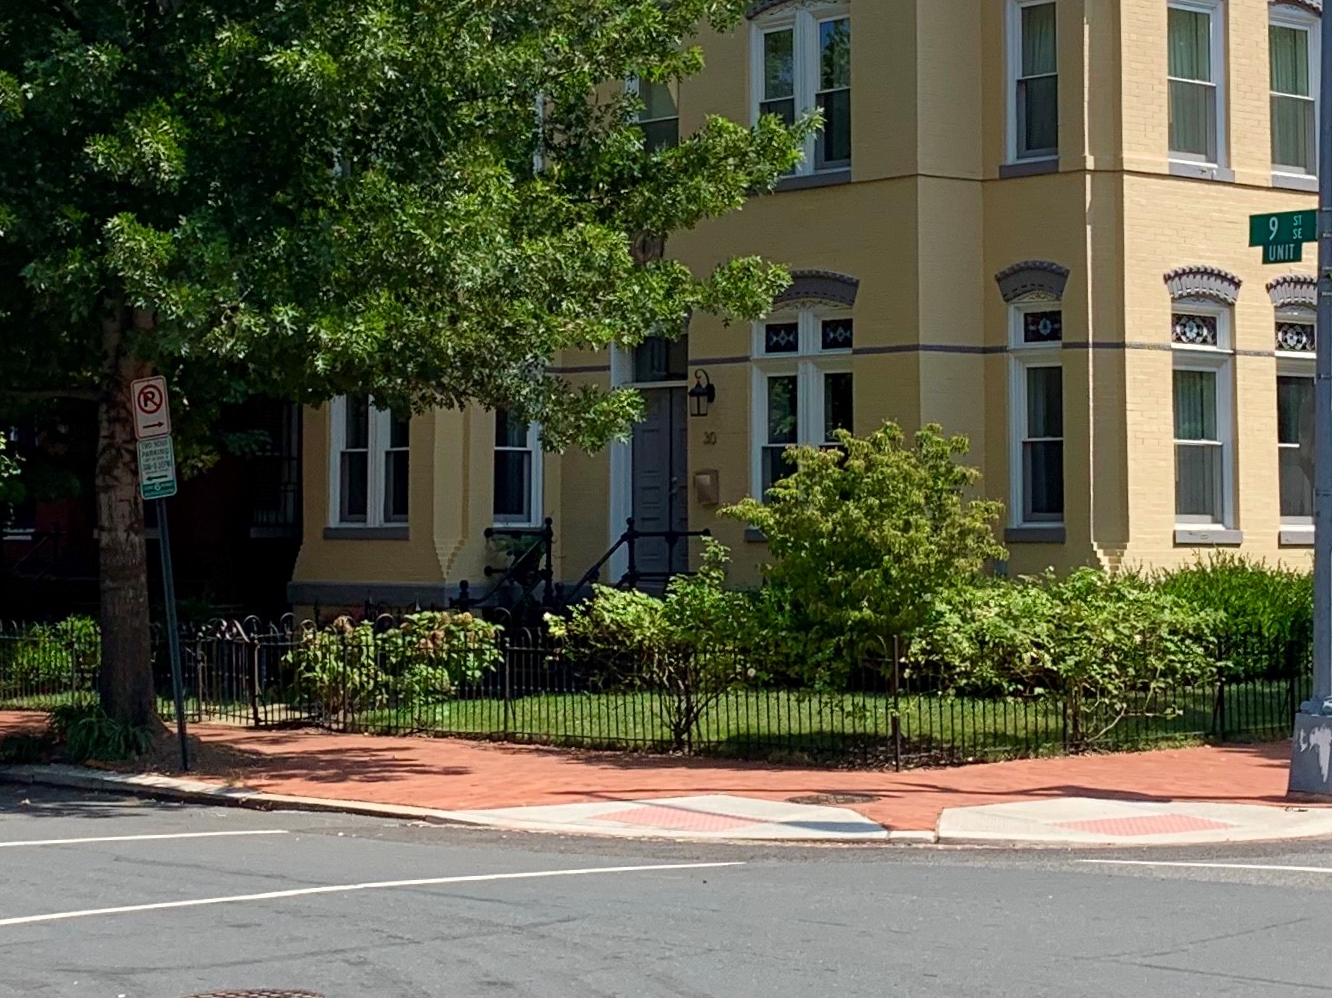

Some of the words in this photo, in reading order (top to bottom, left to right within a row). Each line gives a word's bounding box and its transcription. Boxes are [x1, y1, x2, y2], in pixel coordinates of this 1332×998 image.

[1269, 216, 1278, 240] 9
[1293, 215, 1302, 226] ST
[1292, 228, 1302, 239] SE
[1269, 244, 1295, 261] UNIT
